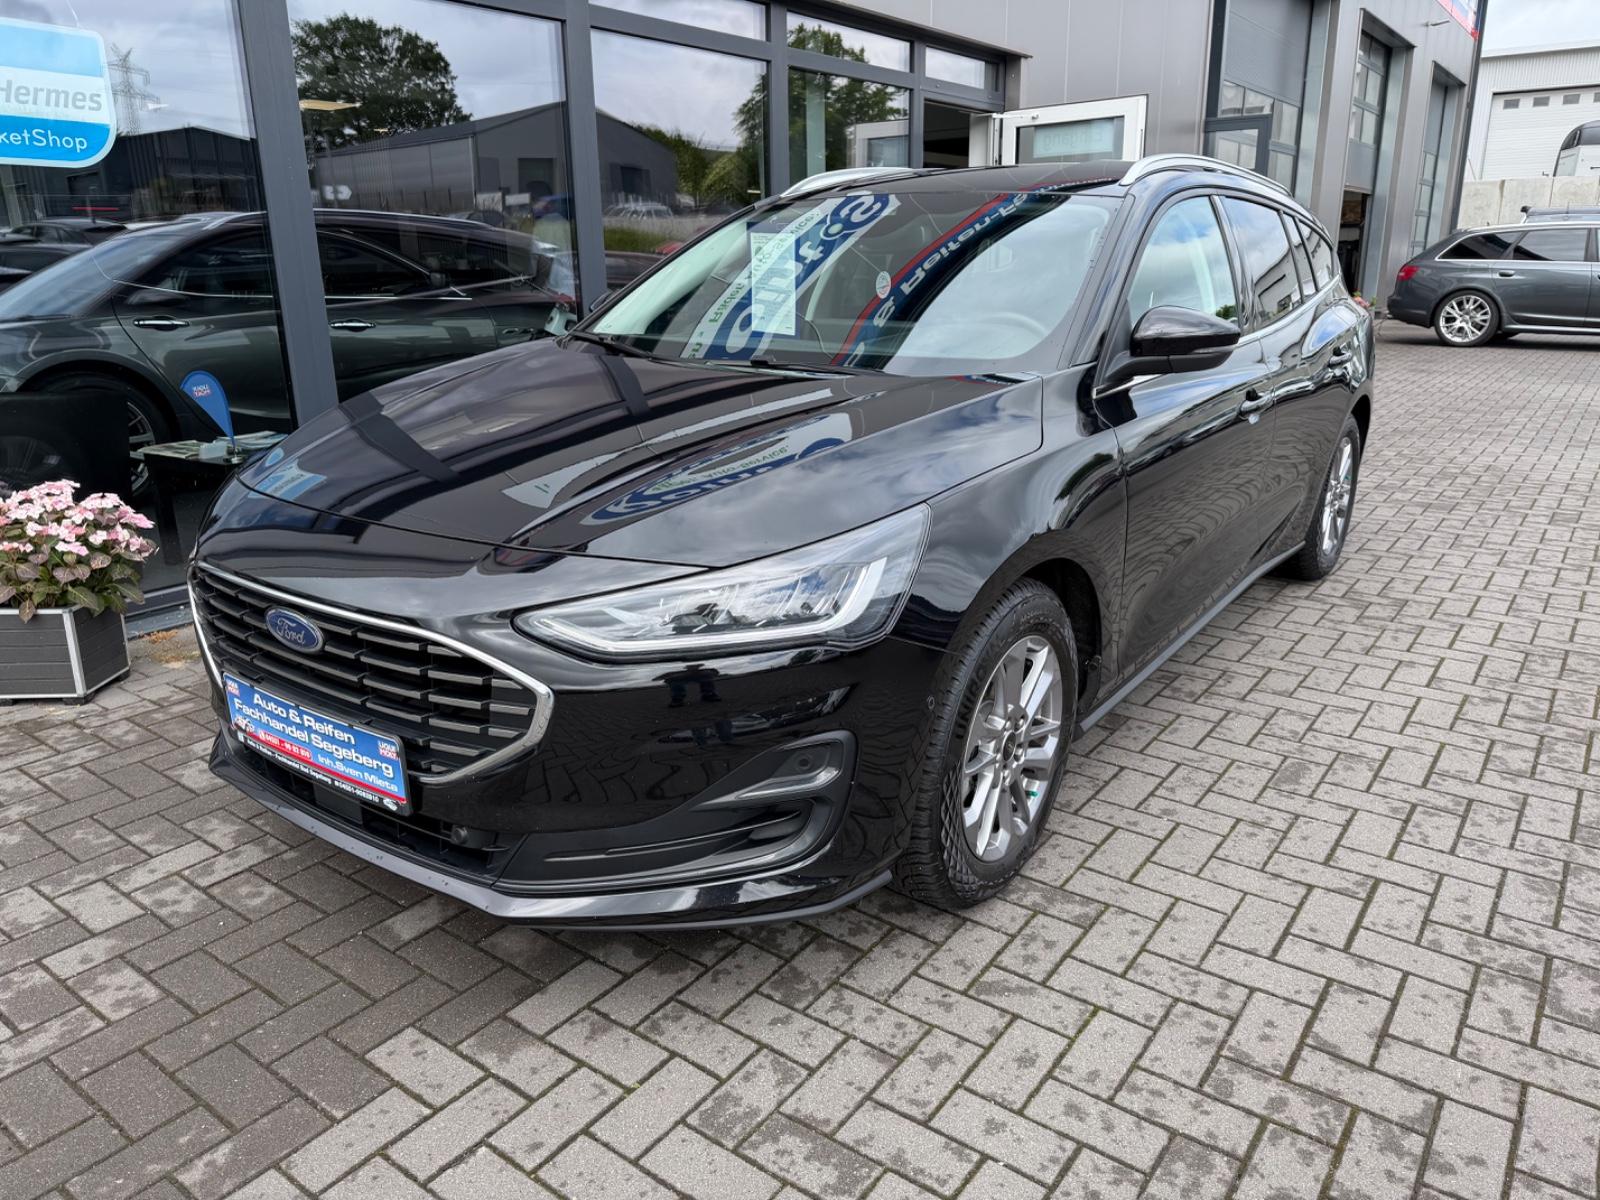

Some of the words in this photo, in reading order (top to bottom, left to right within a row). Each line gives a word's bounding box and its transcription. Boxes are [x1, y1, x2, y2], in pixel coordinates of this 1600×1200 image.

[276, 617, 306, 645] Ford
[233, 697, 309, 744] Fachhandel
[311, 733, 394, 778] Segeberg
[253, 693, 288, 718] Auto
[288, 709, 301, 725] &
[302, 714, 356, 745] Reifen
